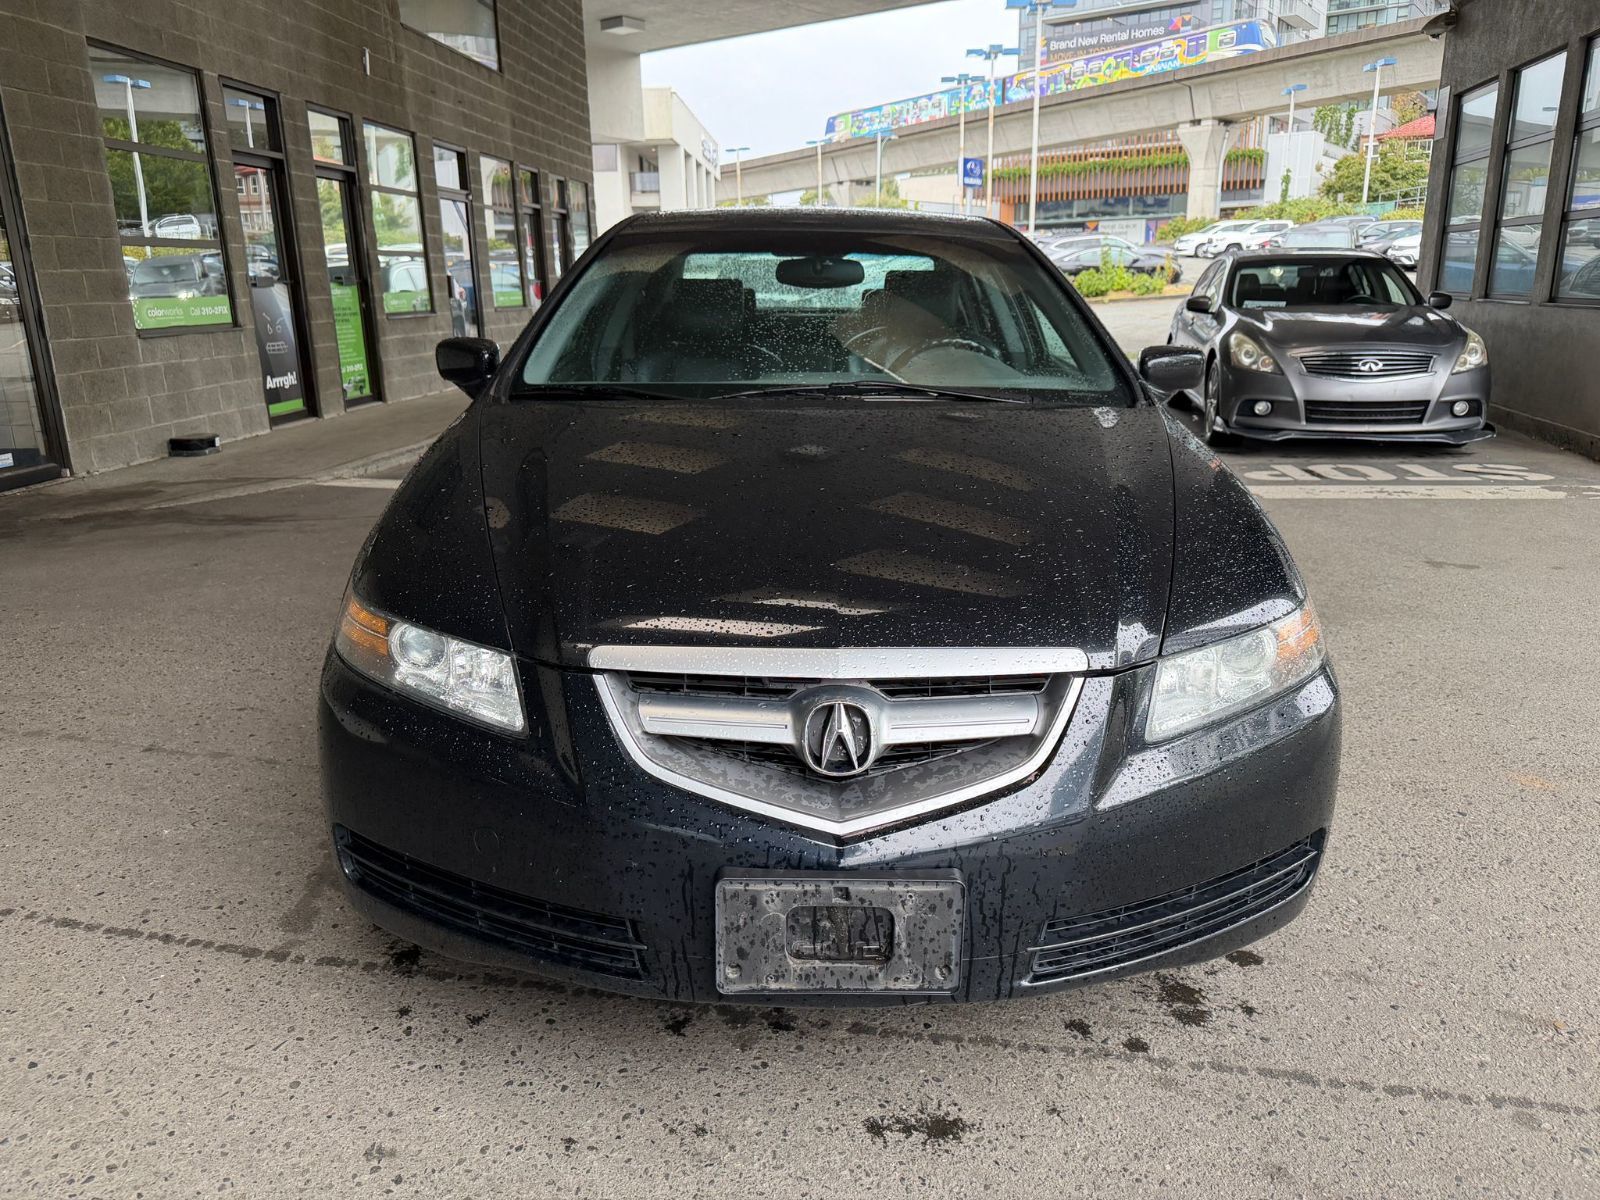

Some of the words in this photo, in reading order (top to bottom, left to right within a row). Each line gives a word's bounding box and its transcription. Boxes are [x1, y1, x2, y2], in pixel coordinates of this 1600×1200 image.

[1050, 38, 1077, 51] Brand
[1078, 36, 1098, 47] New
[1100, 29, 1129, 44] Rental
[1131, 26, 1165, 40] Homes
[190, 307, 200, 316] Call
[201, 305, 229, 316] 310-2FIX
[266, 371, 297, 390] Arrrgh!
[1243, 463, 1556, 482] STOP
